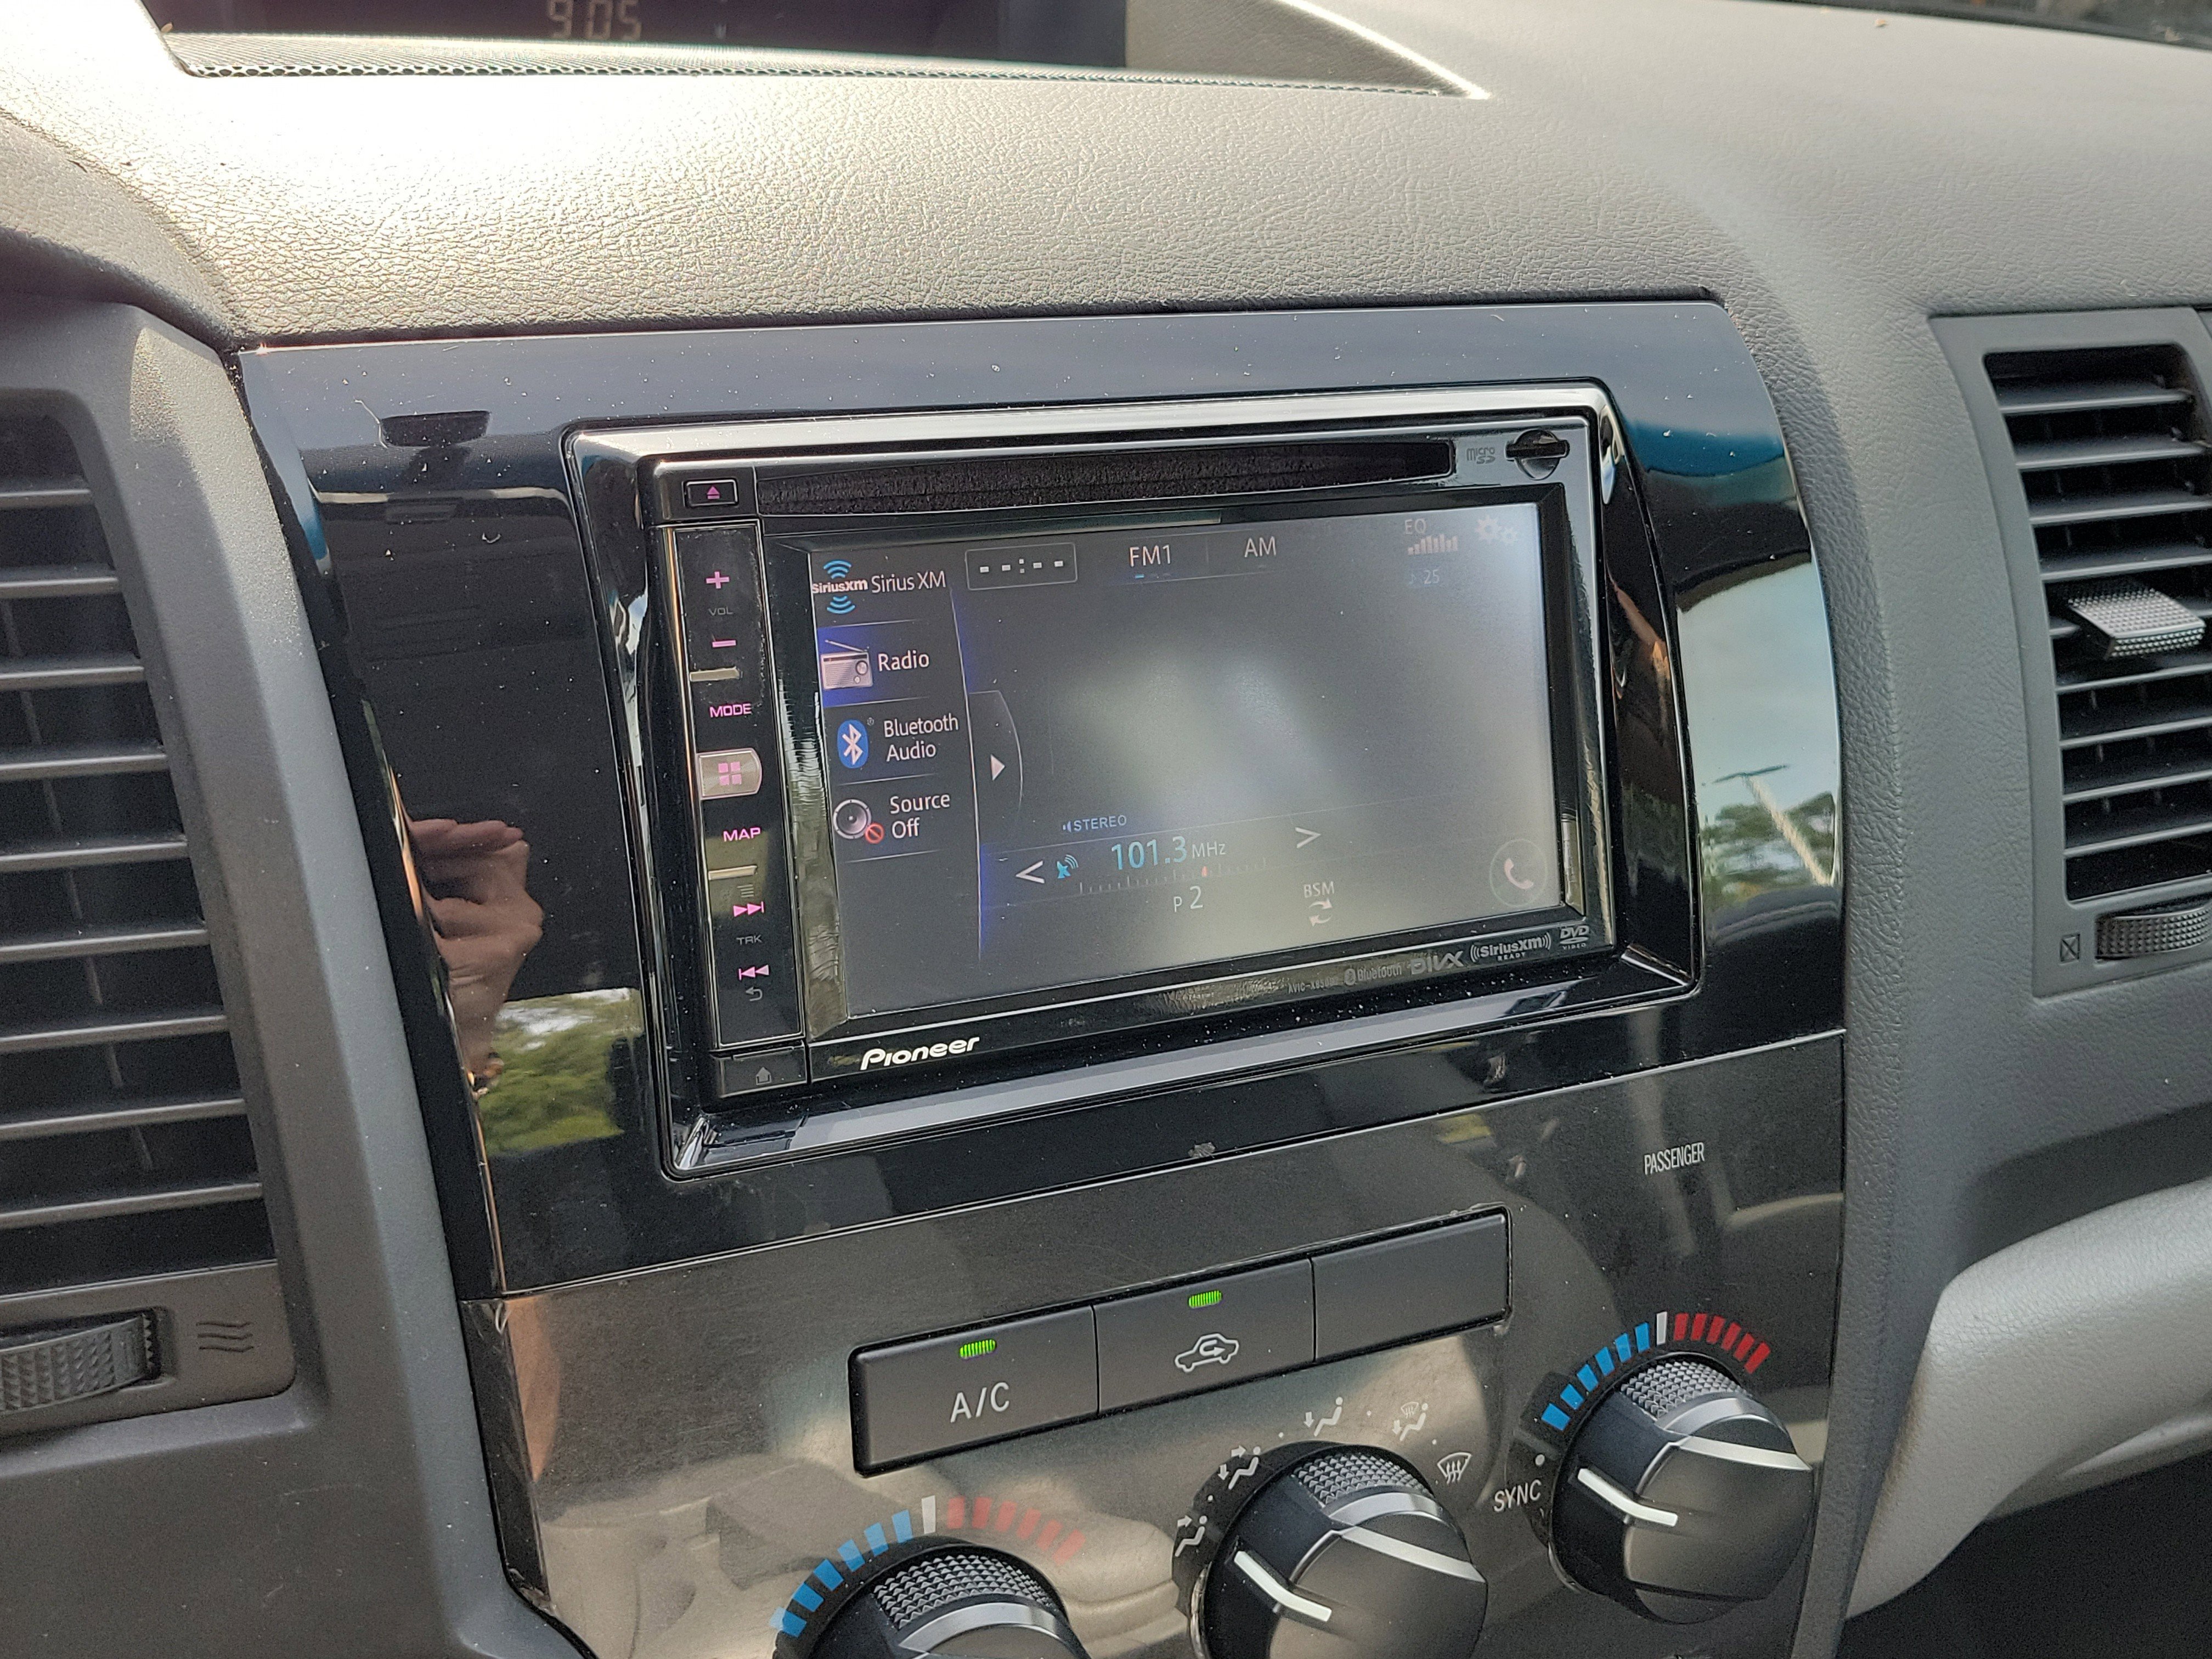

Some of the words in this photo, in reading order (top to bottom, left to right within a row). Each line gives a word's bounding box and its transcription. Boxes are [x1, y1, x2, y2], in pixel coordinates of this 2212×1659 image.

[1405, 518, 1426, 535] EQ
[1129, 544, 1171, 567] FM1
[1244, 536, 1277, 558] AM
[871, 573, 915, 594] Sirius
[917, 570, 946, 590] XM
[1424, 568, 1440, 584] 25
[708, 607, 733, 616] VOL
[877, 650, 930, 673] Radio
[709, 703, 752, 718] MODE
[883, 713, 960, 738] Bluetooth
[886, 742, 937, 762] Audio
[889, 792, 951, 814] Source
[891, 817, 921, 840] Off
[1073, 815, 1127, 832] STEREO
[723, 827, 761, 842] MAP
[1111, 836, 1188, 871] 101.3
[1191, 841, 1227, 859] MHz
[1303, 881, 1335, 899] BSM
[736, 934, 762, 945] TRK
[1560, 924, 1590, 939] DVD
[1497, 952, 1527, 962] READY
[1357, 963, 1402, 981] Bluetooth
[860, 1036, 980, 1071] Pioneer
[1644, 1142, 1705, 1175] PASSENGER
[950, 1381, 1011, 1424] A/C
[1493, 1480, 1542, 1513] SYNC
